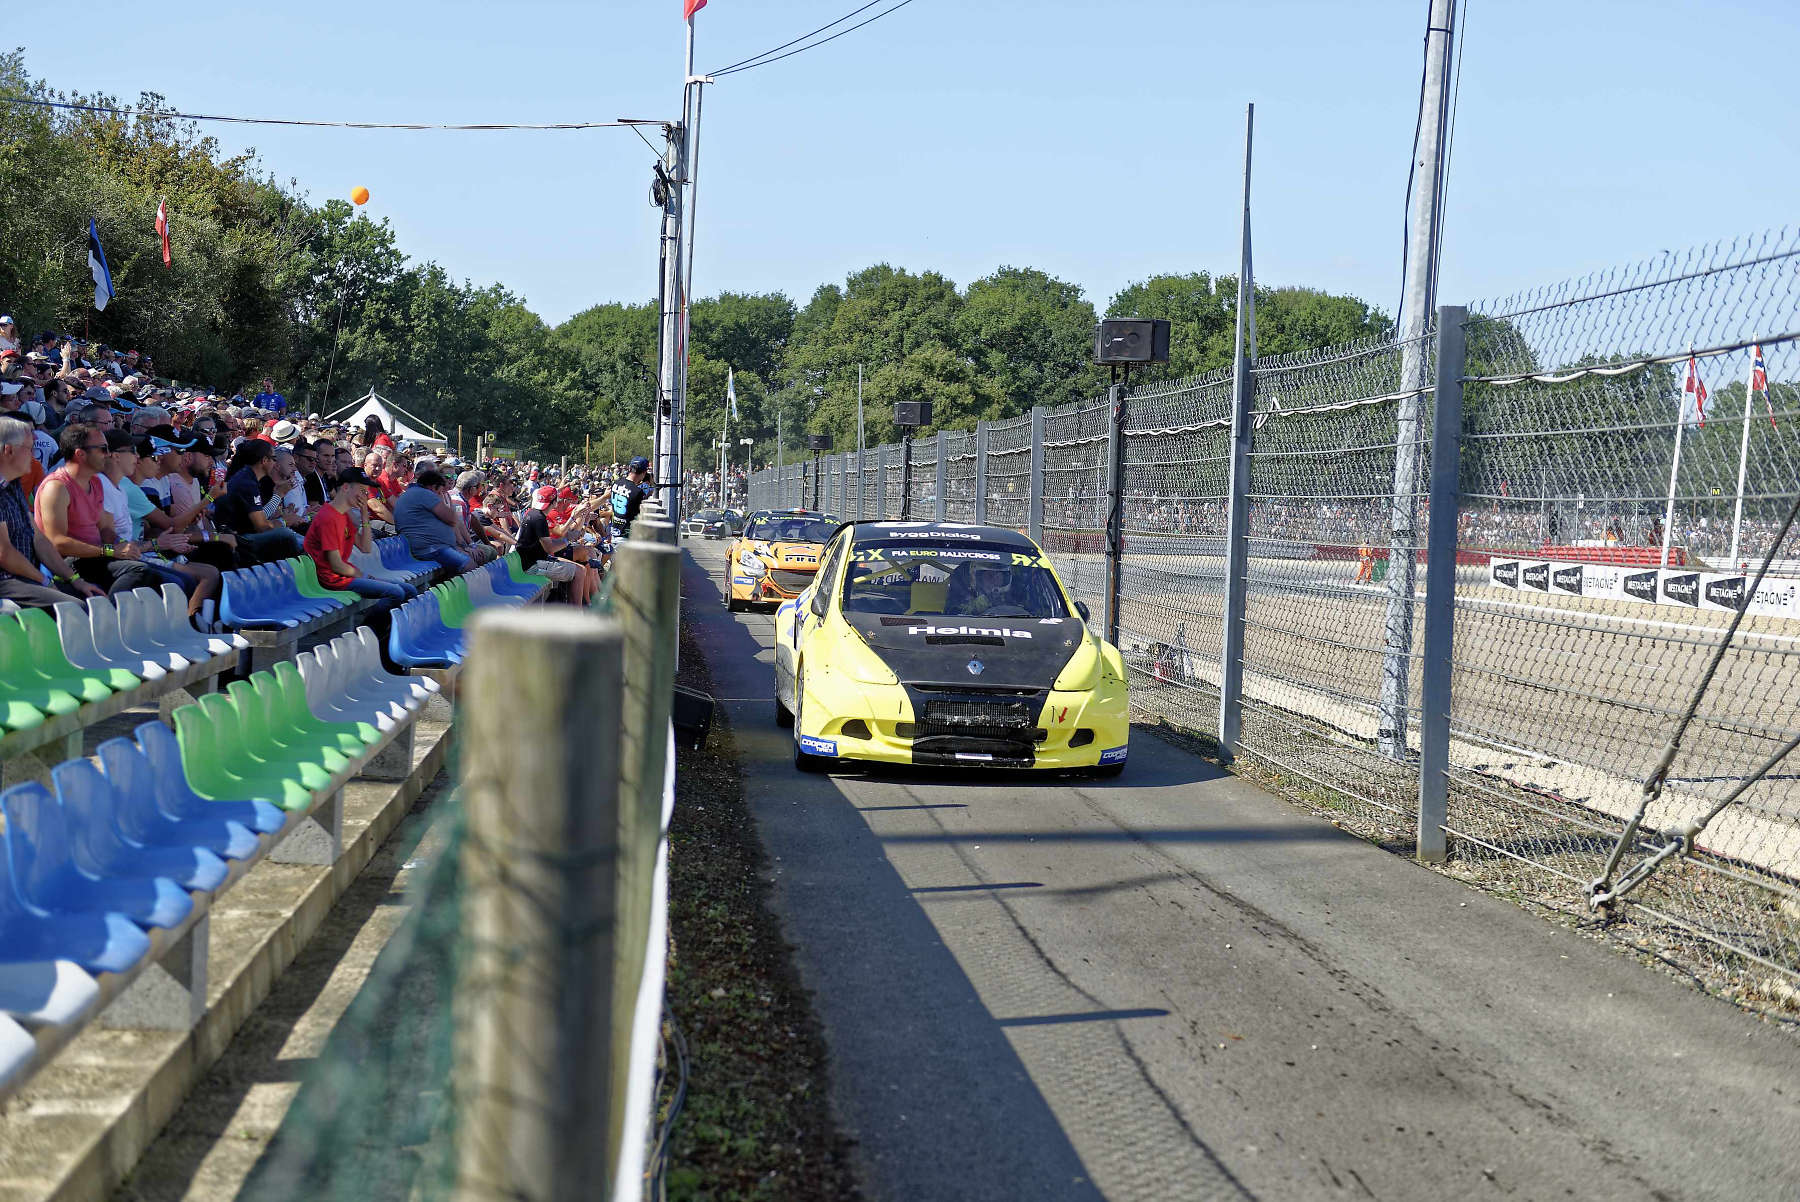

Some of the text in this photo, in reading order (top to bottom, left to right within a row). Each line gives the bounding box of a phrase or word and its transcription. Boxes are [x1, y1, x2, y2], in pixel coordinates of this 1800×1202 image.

[1712, 488, 1720, 496] M
[909, 550, 938, 558] EURO
[939, 551, 1001, 561] RALLYCROSS
